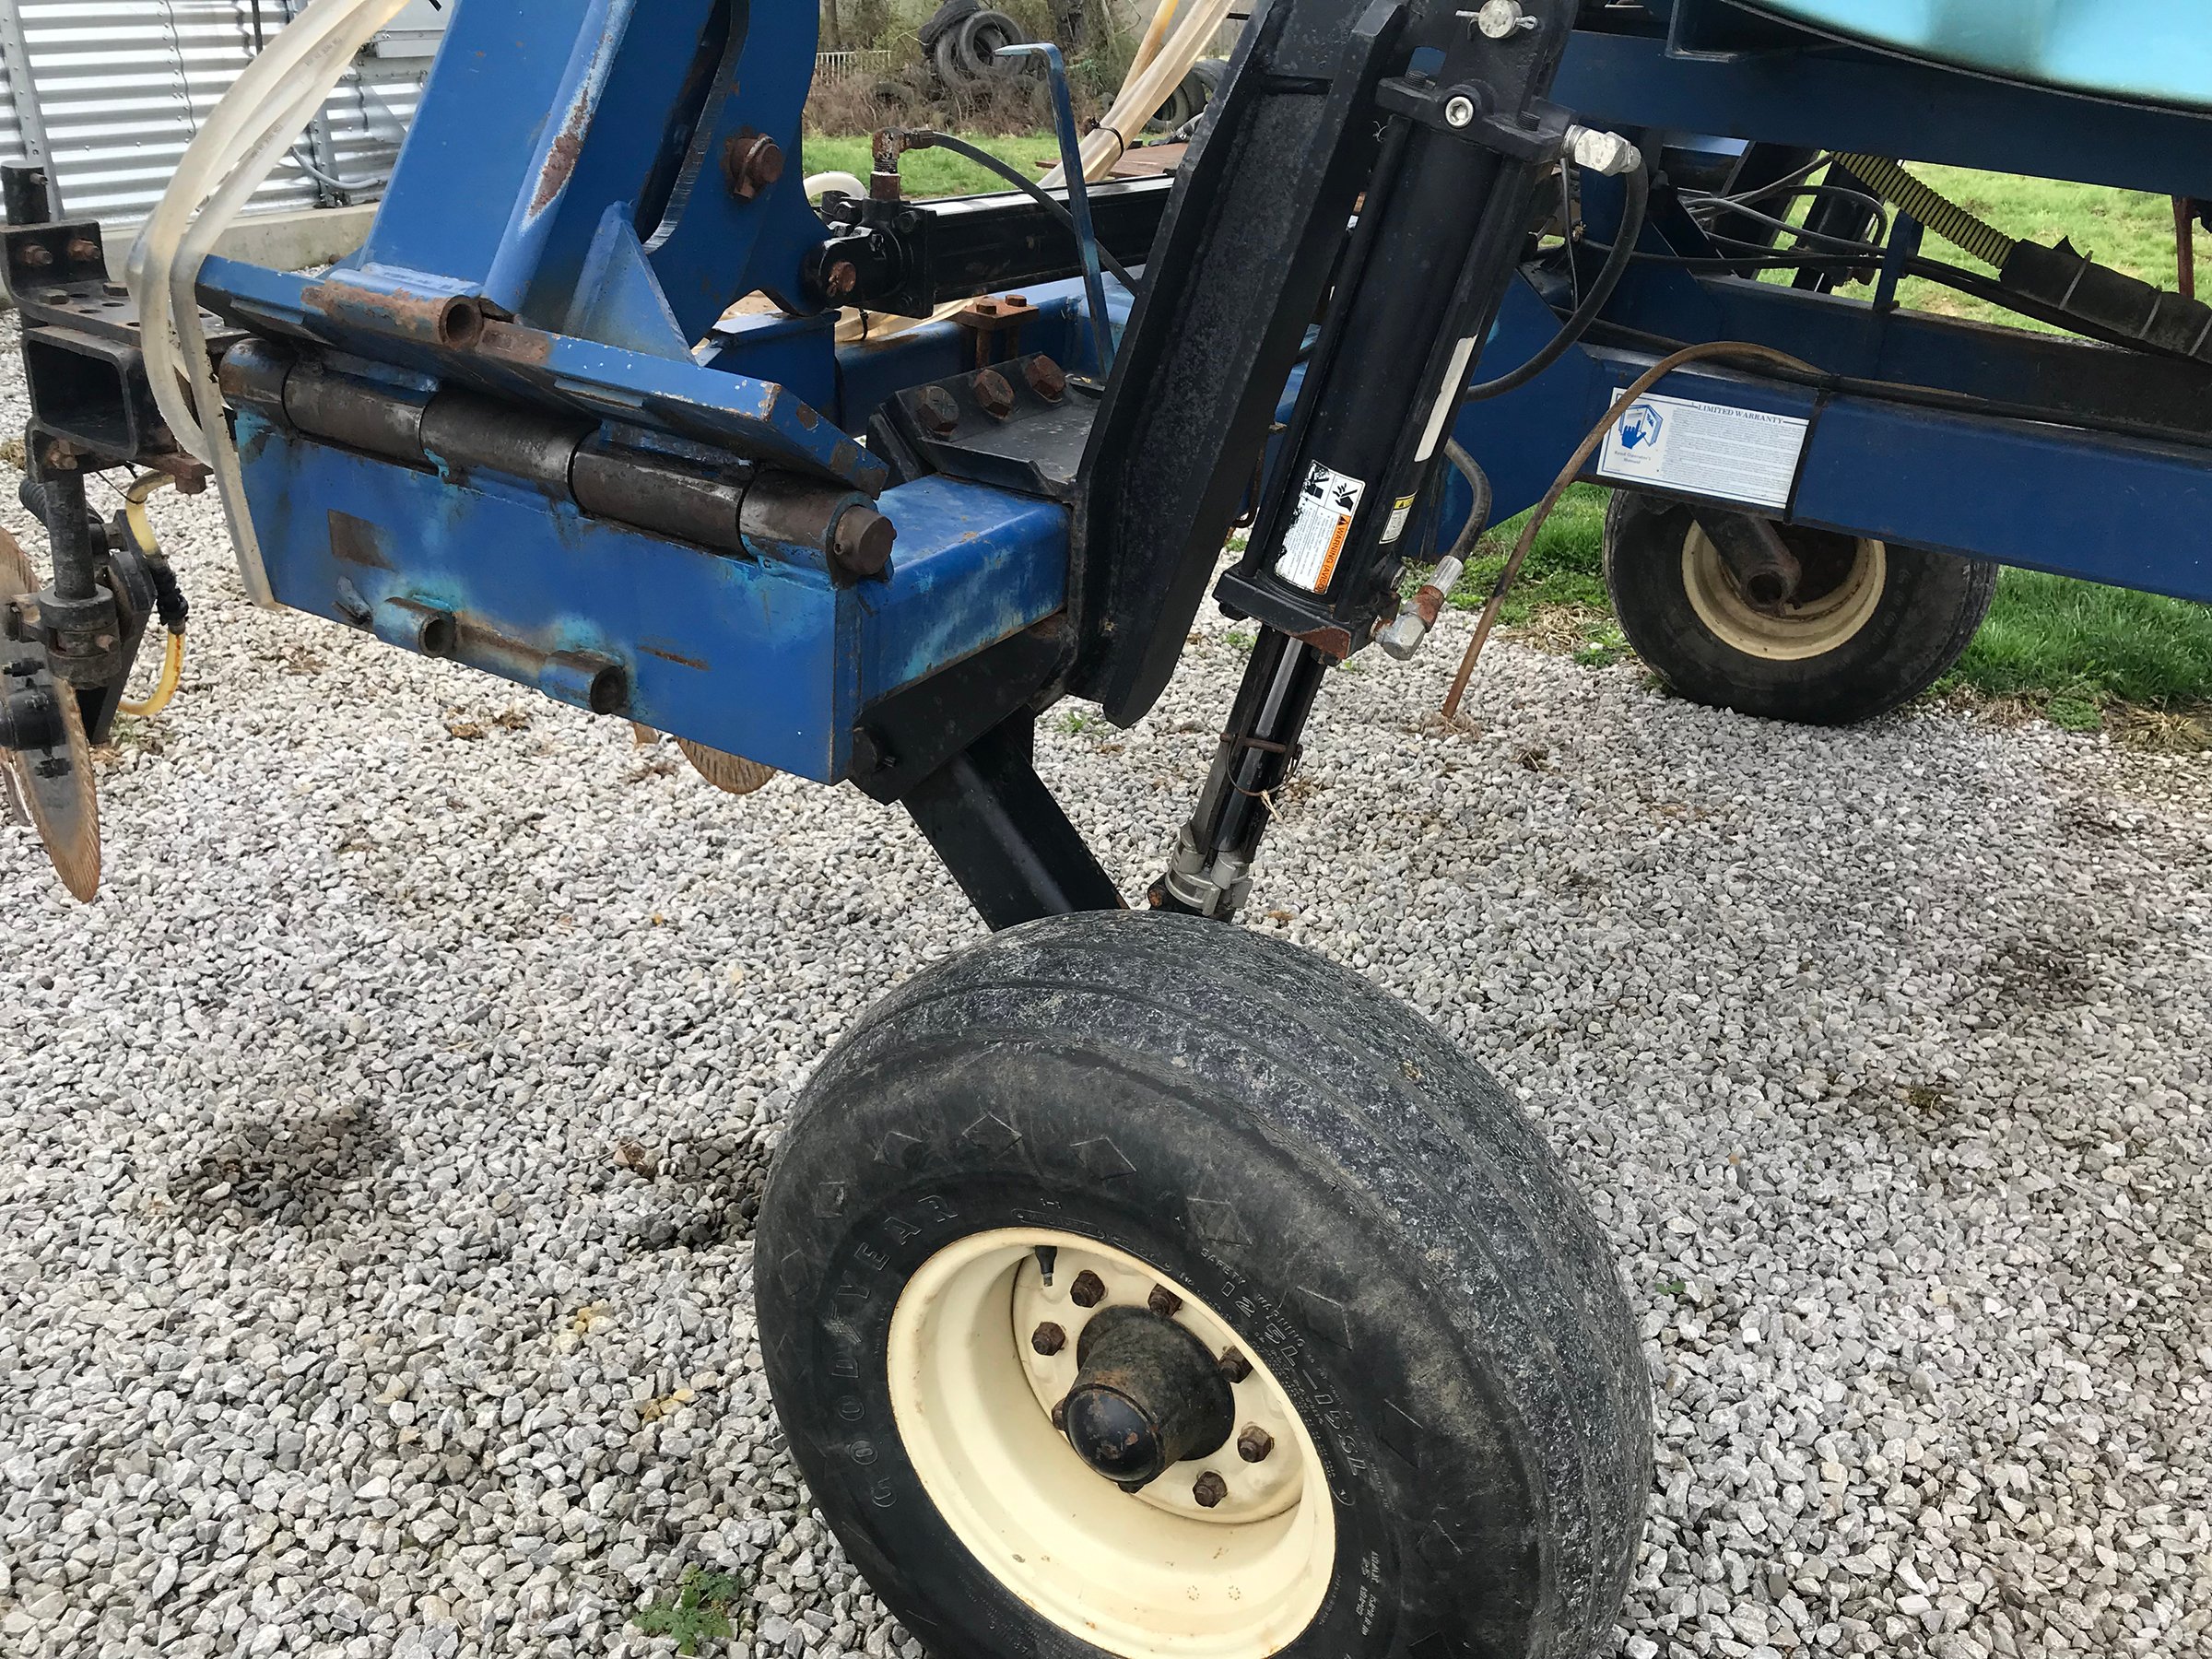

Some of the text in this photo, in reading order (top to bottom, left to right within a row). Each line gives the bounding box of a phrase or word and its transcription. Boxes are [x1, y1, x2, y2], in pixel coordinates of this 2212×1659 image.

[1698, 405, 1784, 425] LIMITED WARRANTY
[1326, 526, 1346, 563] WARNING
[1200, 1247, 1246, 1285] SAFETY
[831, 1194, 959, 1509] GOODYEAR
